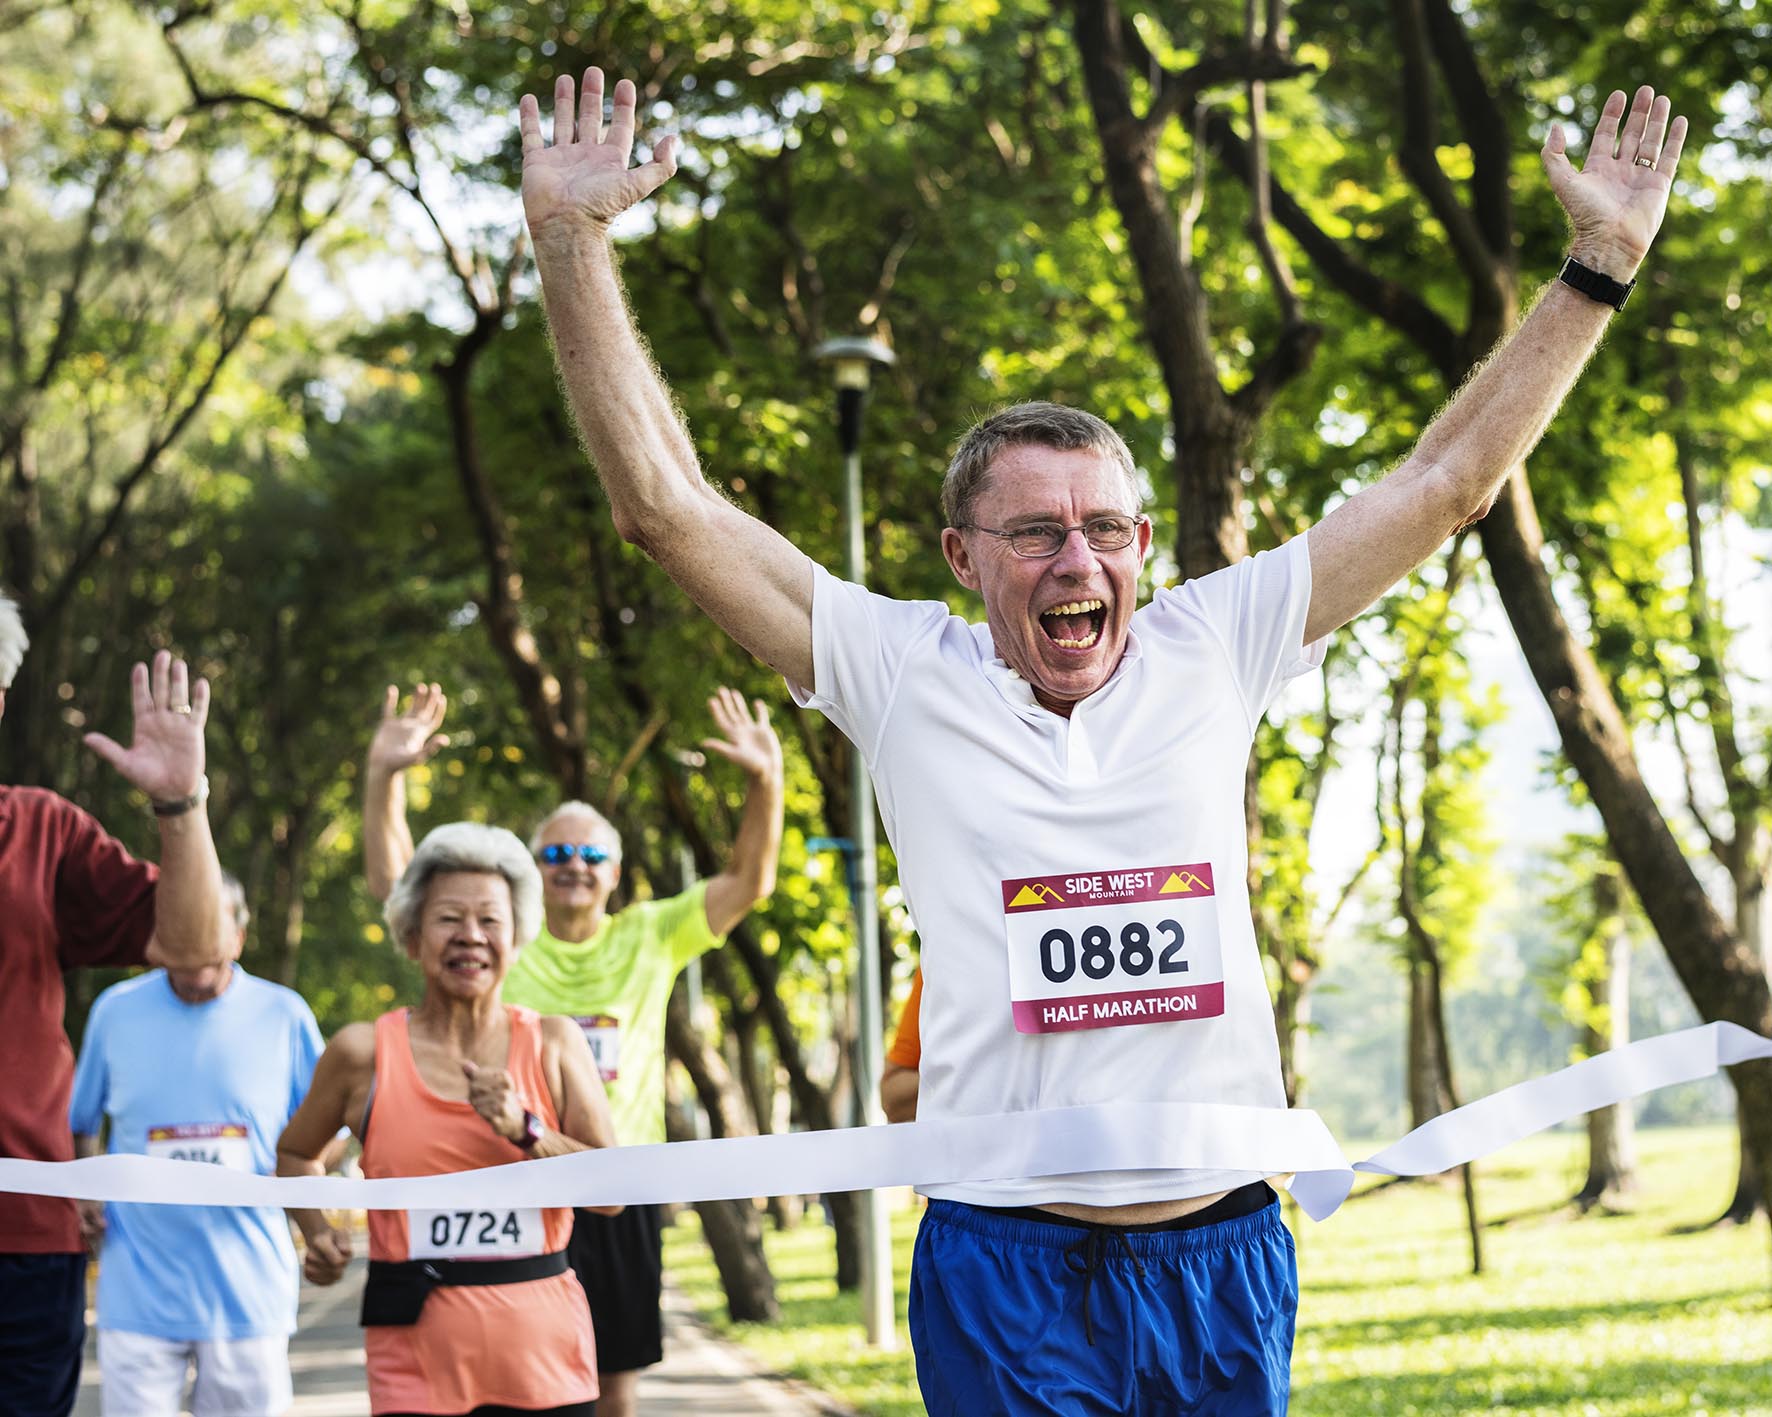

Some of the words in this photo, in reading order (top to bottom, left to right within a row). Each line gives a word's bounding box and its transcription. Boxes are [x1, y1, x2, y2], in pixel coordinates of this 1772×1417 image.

[1065, 877, 1103, 894] SIDE
[1107, 872, 1154, 891] WEST
[1089, 890, 1134, 899] MOUNTAIN
[1039, 918, 1189, 983] 0882
[1043, 1004, 1089, 1024] HALF
[1092, 994, 1197, 1020] MARATHON
[430, 1211, 521, 1246] 0724
